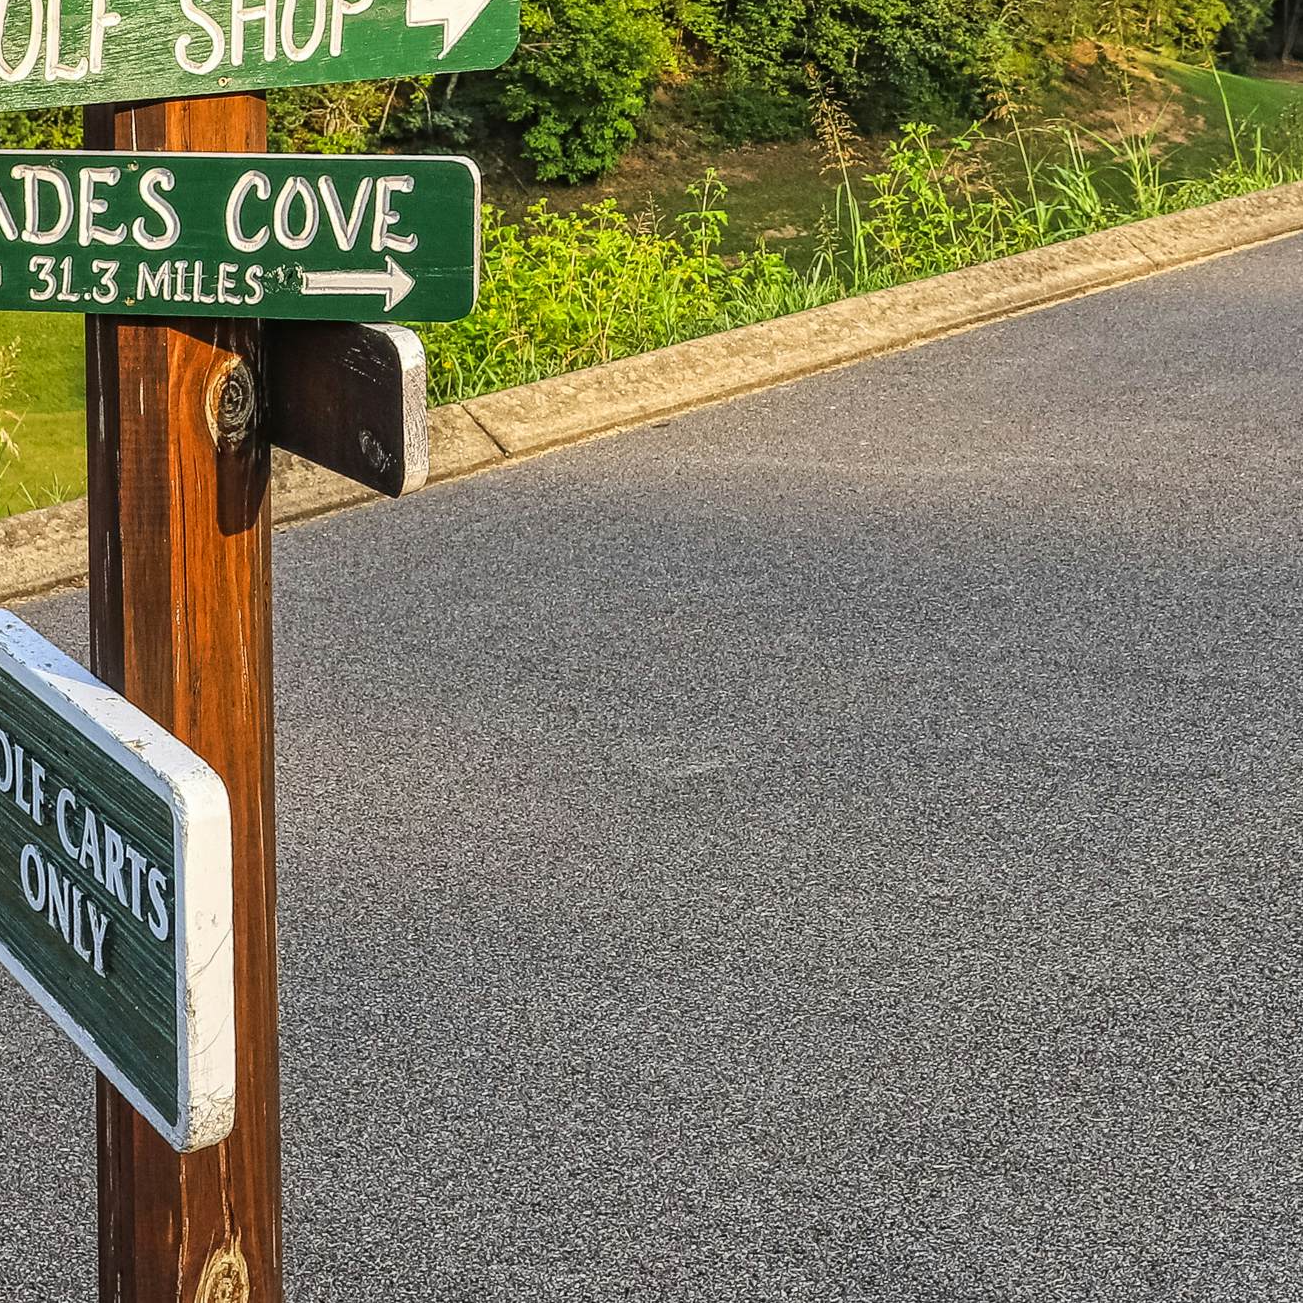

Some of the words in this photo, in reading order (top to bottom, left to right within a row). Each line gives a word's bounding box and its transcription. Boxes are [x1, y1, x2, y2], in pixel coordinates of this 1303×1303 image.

[225, 169, 419, 253] COVE
[27, 254, 119, 305] 31.3
[136, 258, 265, 306] MILES
[20, 843, 111, 979] ONLY
[55, 787, 170, 943] CARTS
